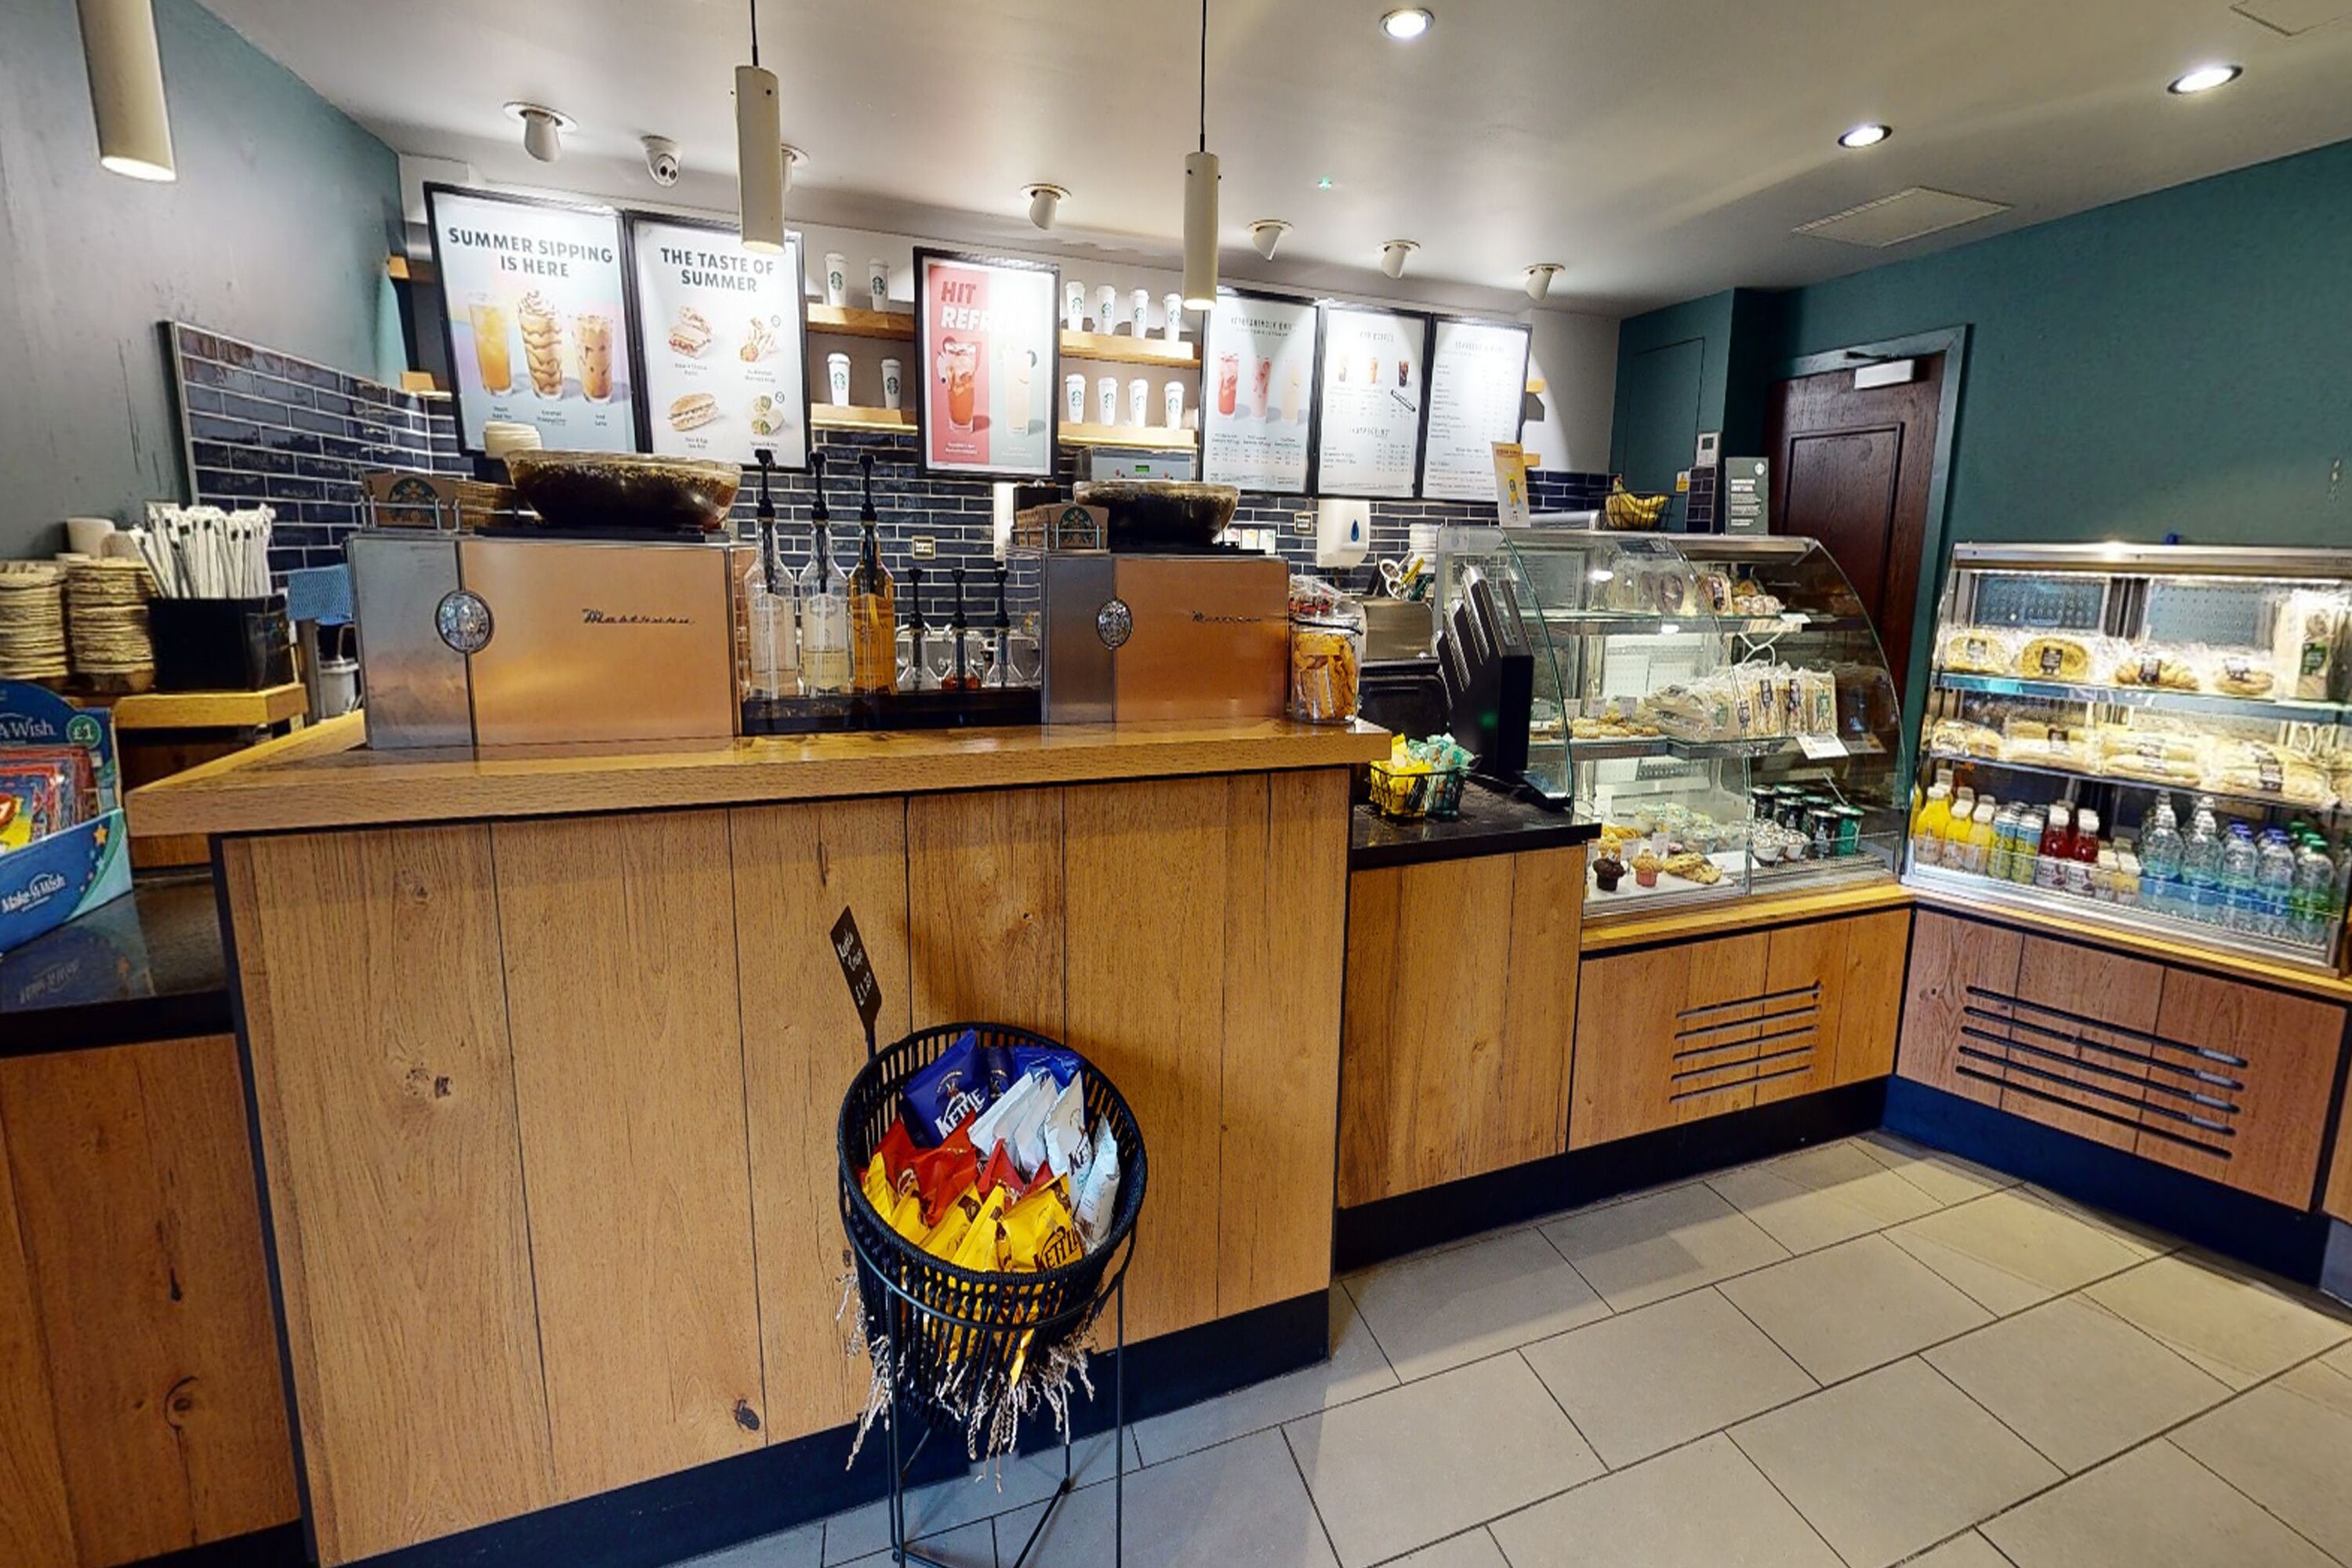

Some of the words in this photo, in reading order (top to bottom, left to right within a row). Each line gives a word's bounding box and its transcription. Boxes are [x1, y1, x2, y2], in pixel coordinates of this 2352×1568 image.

[448, 227, 533, 253] SUMMER
[539, 240, 613, 263] SIPPING
[500, 255, 517, 271] IS
[523, 258, 569, 278] HERE
[661, 247, 693, 266] THE
[698, 252, 748, 273] TASTE
[753, 260, 774, 275] OF
[681, 269, 757, 292] SUMMER
[942, 281, 977, 304] HIT
[74, 723, 94, 740] £1
[935, 1088, 986, 1140] KETTLE
